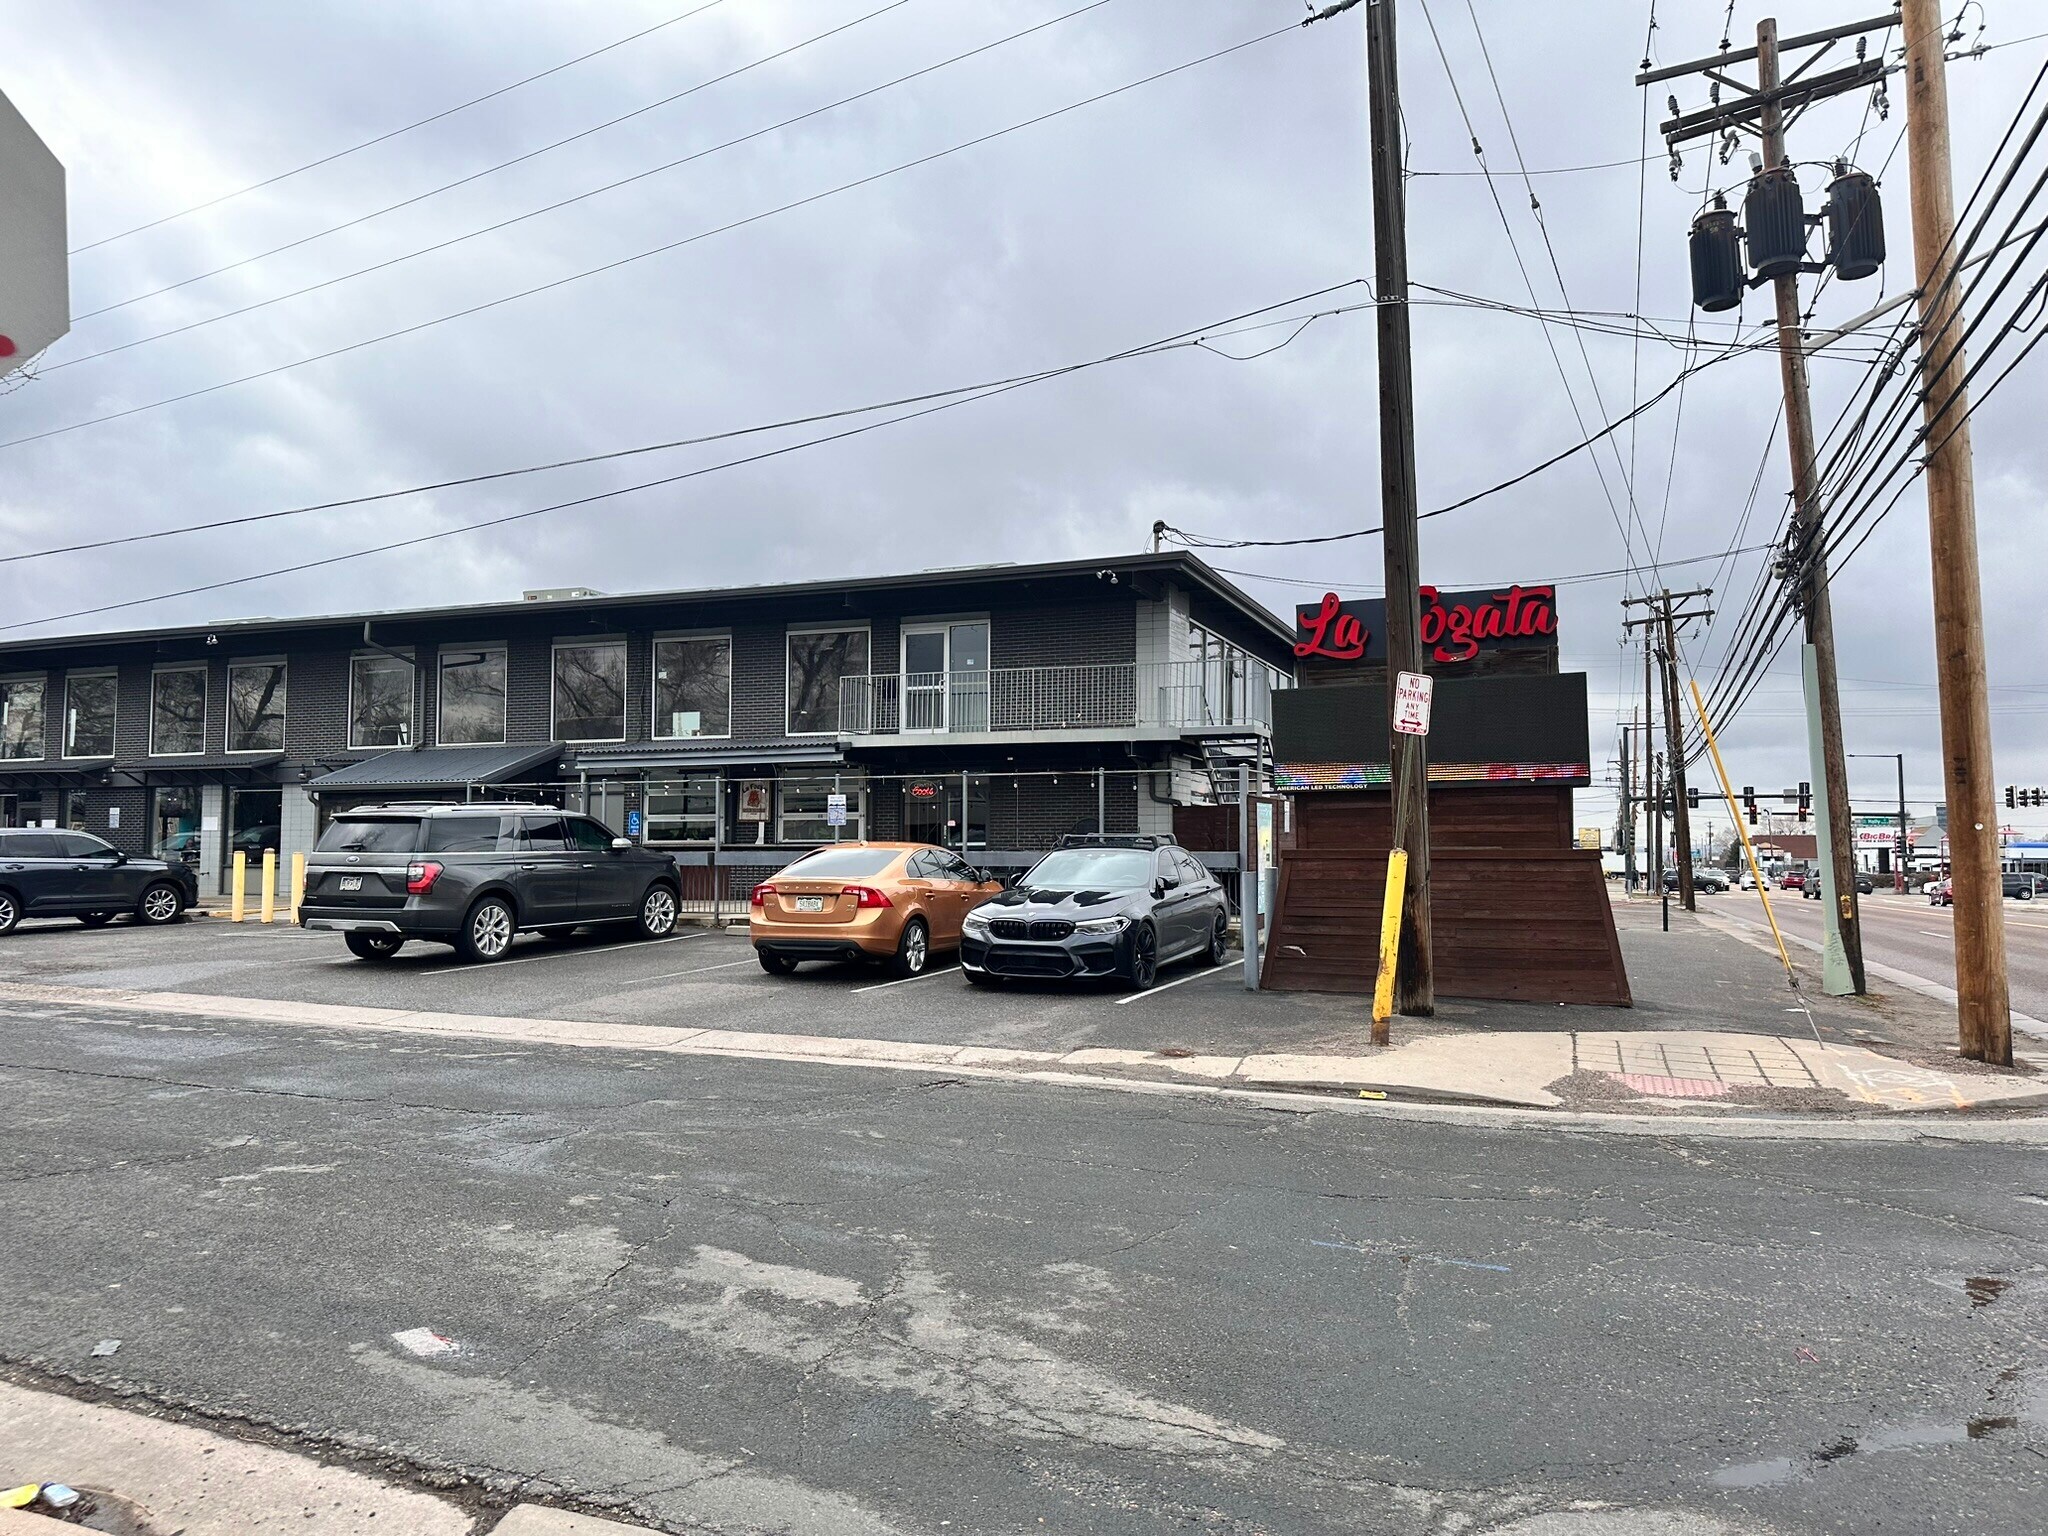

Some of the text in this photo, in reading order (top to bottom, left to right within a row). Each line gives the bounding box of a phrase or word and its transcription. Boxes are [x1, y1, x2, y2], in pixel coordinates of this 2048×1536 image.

[1294, 591, 1369, 660] La
[1410, 677, 1420, 689] NO
[1399, 688, 1429, 703] PARKING
[1405, 702, 1420, 711] ANY
[1404, 710, 1420, 719] TIME
